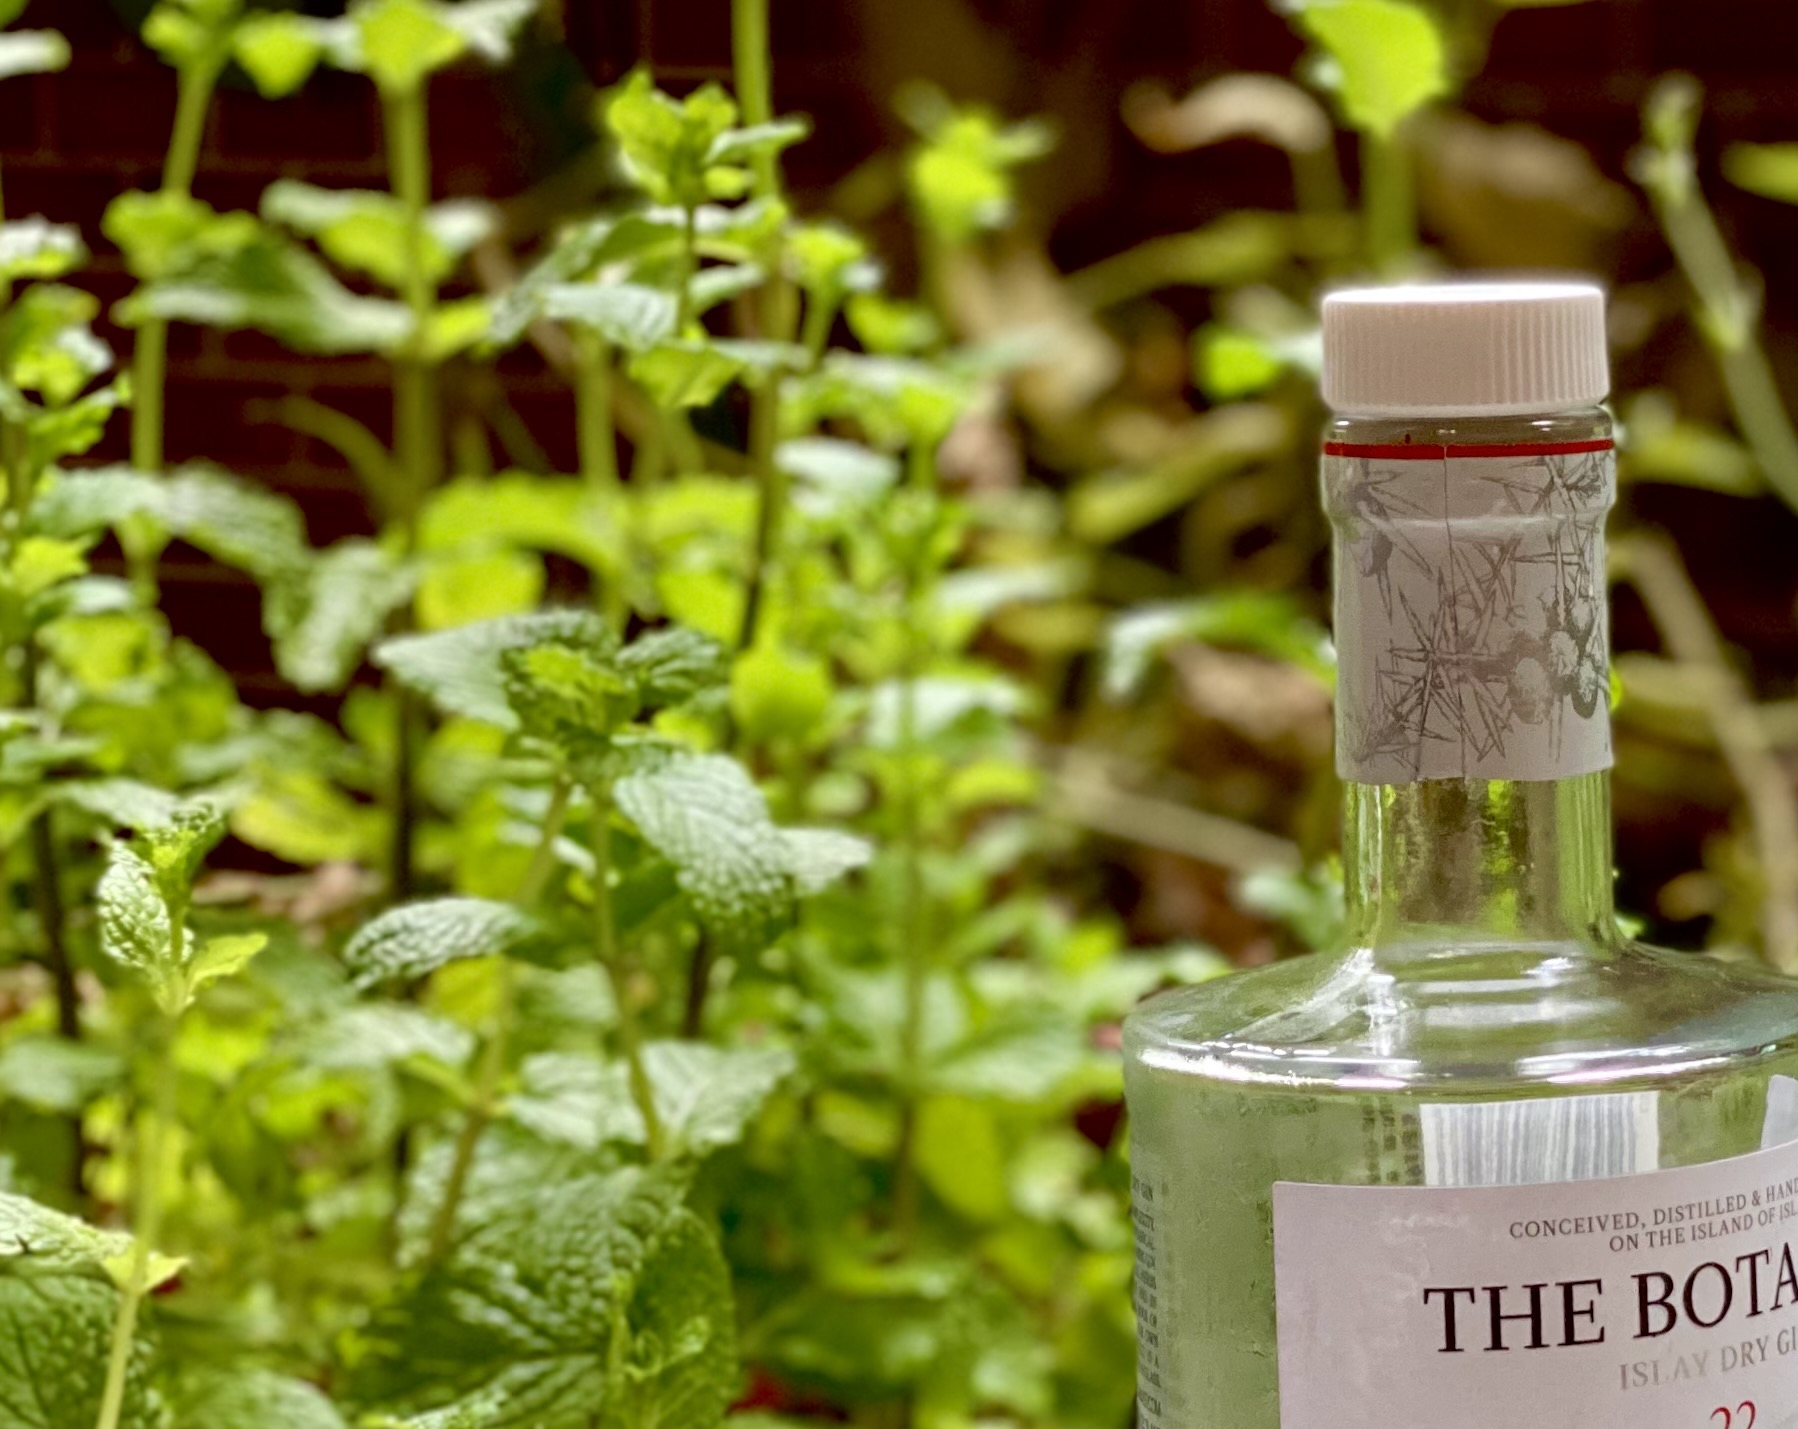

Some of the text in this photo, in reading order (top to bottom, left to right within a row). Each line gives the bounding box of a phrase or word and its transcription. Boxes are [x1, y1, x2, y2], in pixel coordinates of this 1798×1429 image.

[1509, 1211, 1646, 1240] CONCEIVED,
[1653, 1193, 1747, 1227] DISTILLED
[1751, 1189, 1761, 1206] &
[1609, 1232, 1639, 1252] ON
[1645, 1226, 1686, 1249] THE
[1691, 1213, 1754, 1241] ISLAND
[1758, 1207, 1776, 1227] OF
[1423, 1277, 1606, 1354] THE
[1618, 1350, 1709, 1392] ISLAY
[1720, 1335, 1770, 1373] DRY
